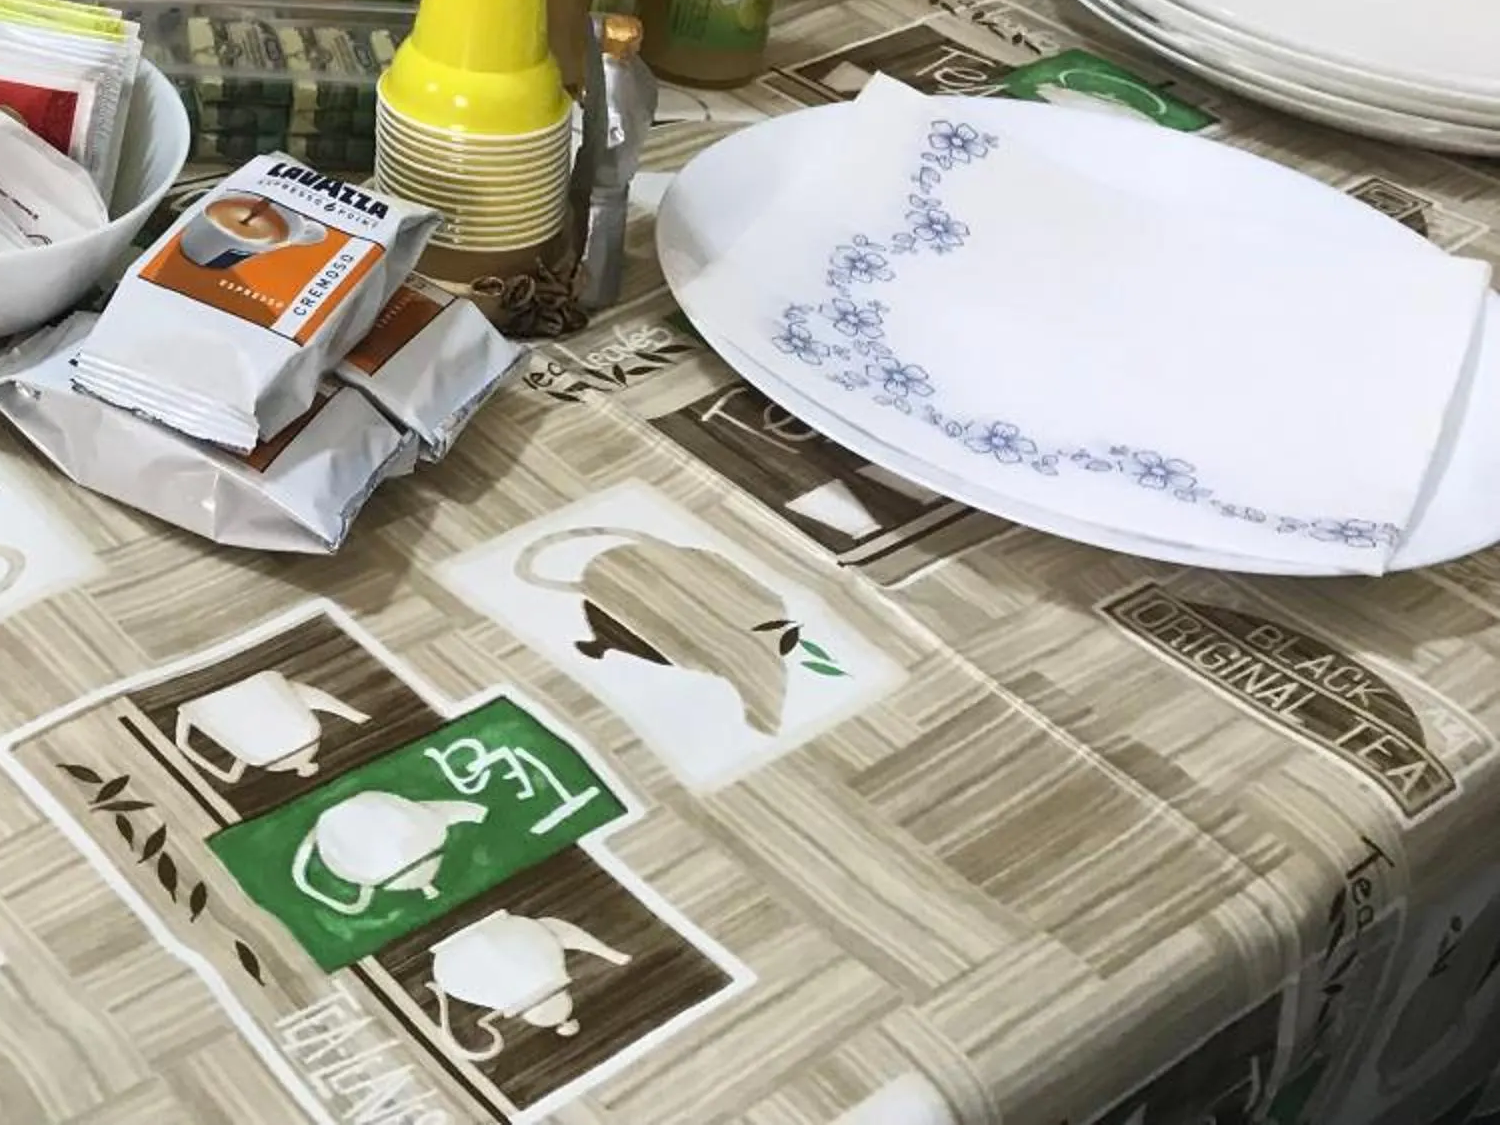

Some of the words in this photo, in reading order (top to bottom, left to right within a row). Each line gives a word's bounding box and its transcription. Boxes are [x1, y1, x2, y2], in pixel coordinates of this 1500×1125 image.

[266, 162, 390, 220] LAVAZZA
[218, 278, 285, 309] ESPRESSO
[292, 253, 356, 317] CREMOSO
[1245, 623, 1389, 709] BLACK
[1130, 599, 1316, 725] ORIGINAL
[1334, 715, 1429, 805] TEA
